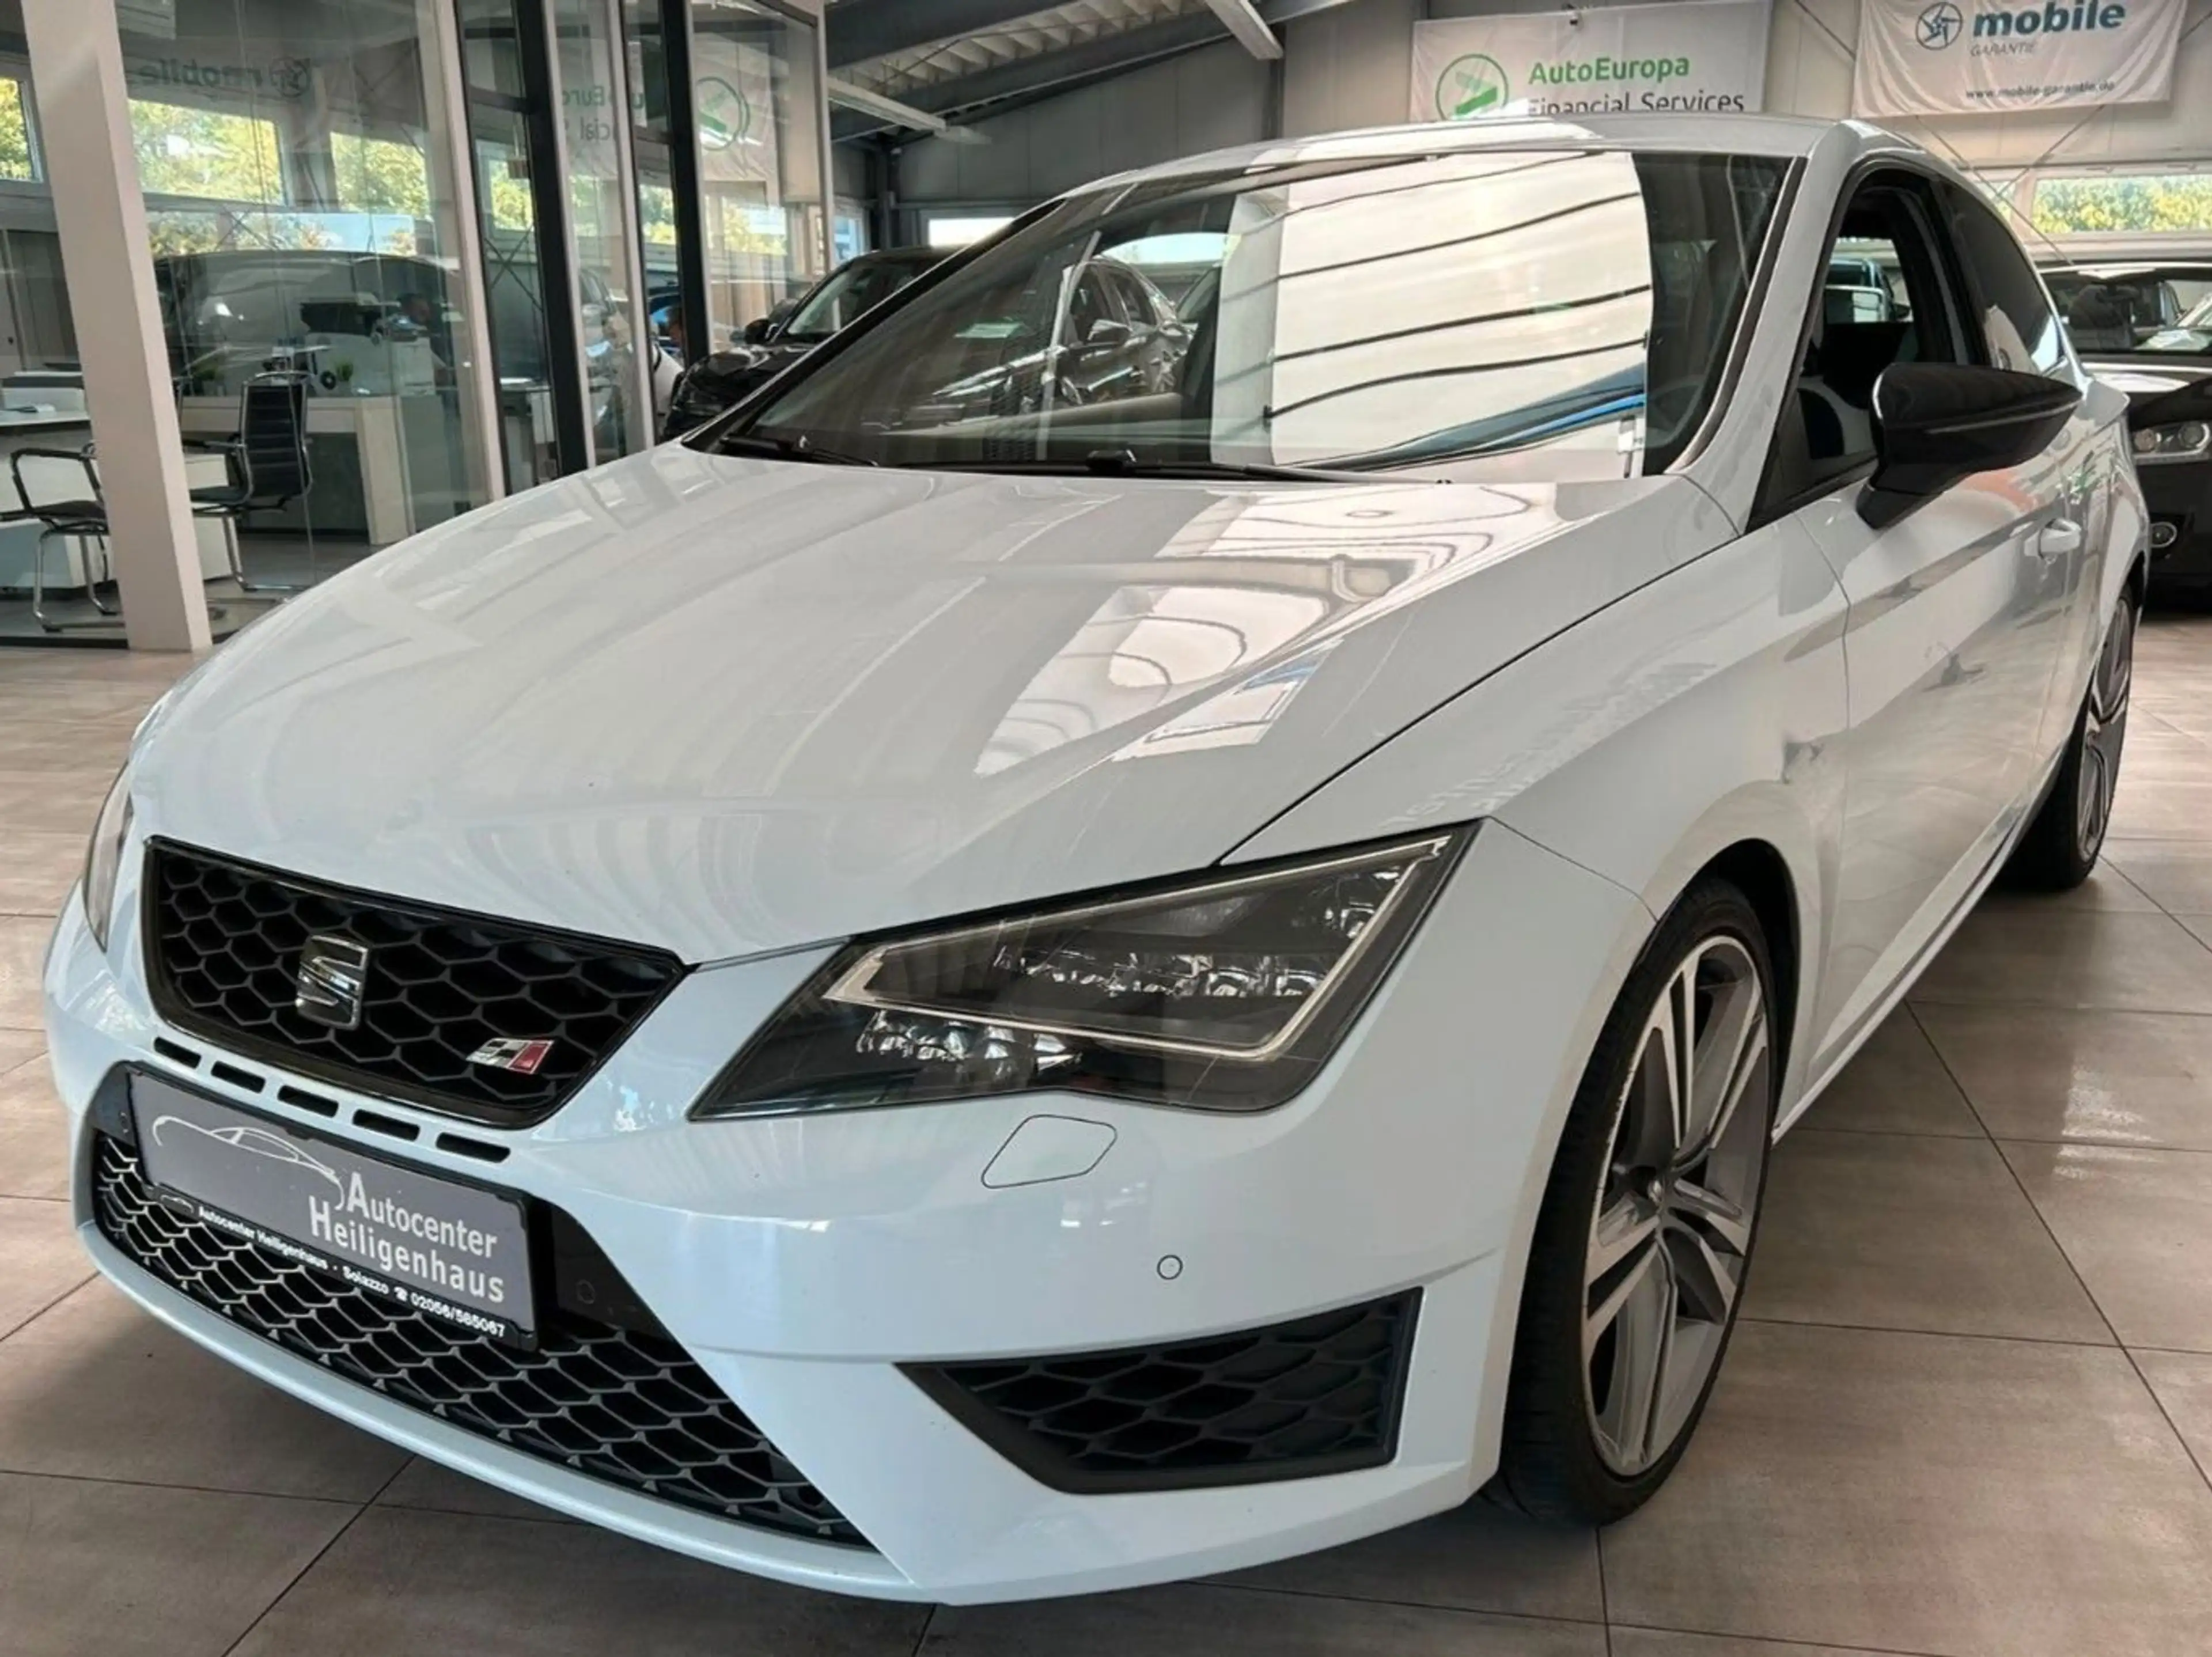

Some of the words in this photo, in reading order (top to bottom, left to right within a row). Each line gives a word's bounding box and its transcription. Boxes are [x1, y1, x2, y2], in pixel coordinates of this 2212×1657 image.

[1973, 0, 2125, 37] mobile
[1528, 56, 1690, 84] AutoEuropa
[1528, 91, 1630, 115] Financial
[1641, 89, 1745, 112] Services
[347, 1171, 499, 1259] Autocenter
[308, 1195, 505, 1304] Heiligenhaus
